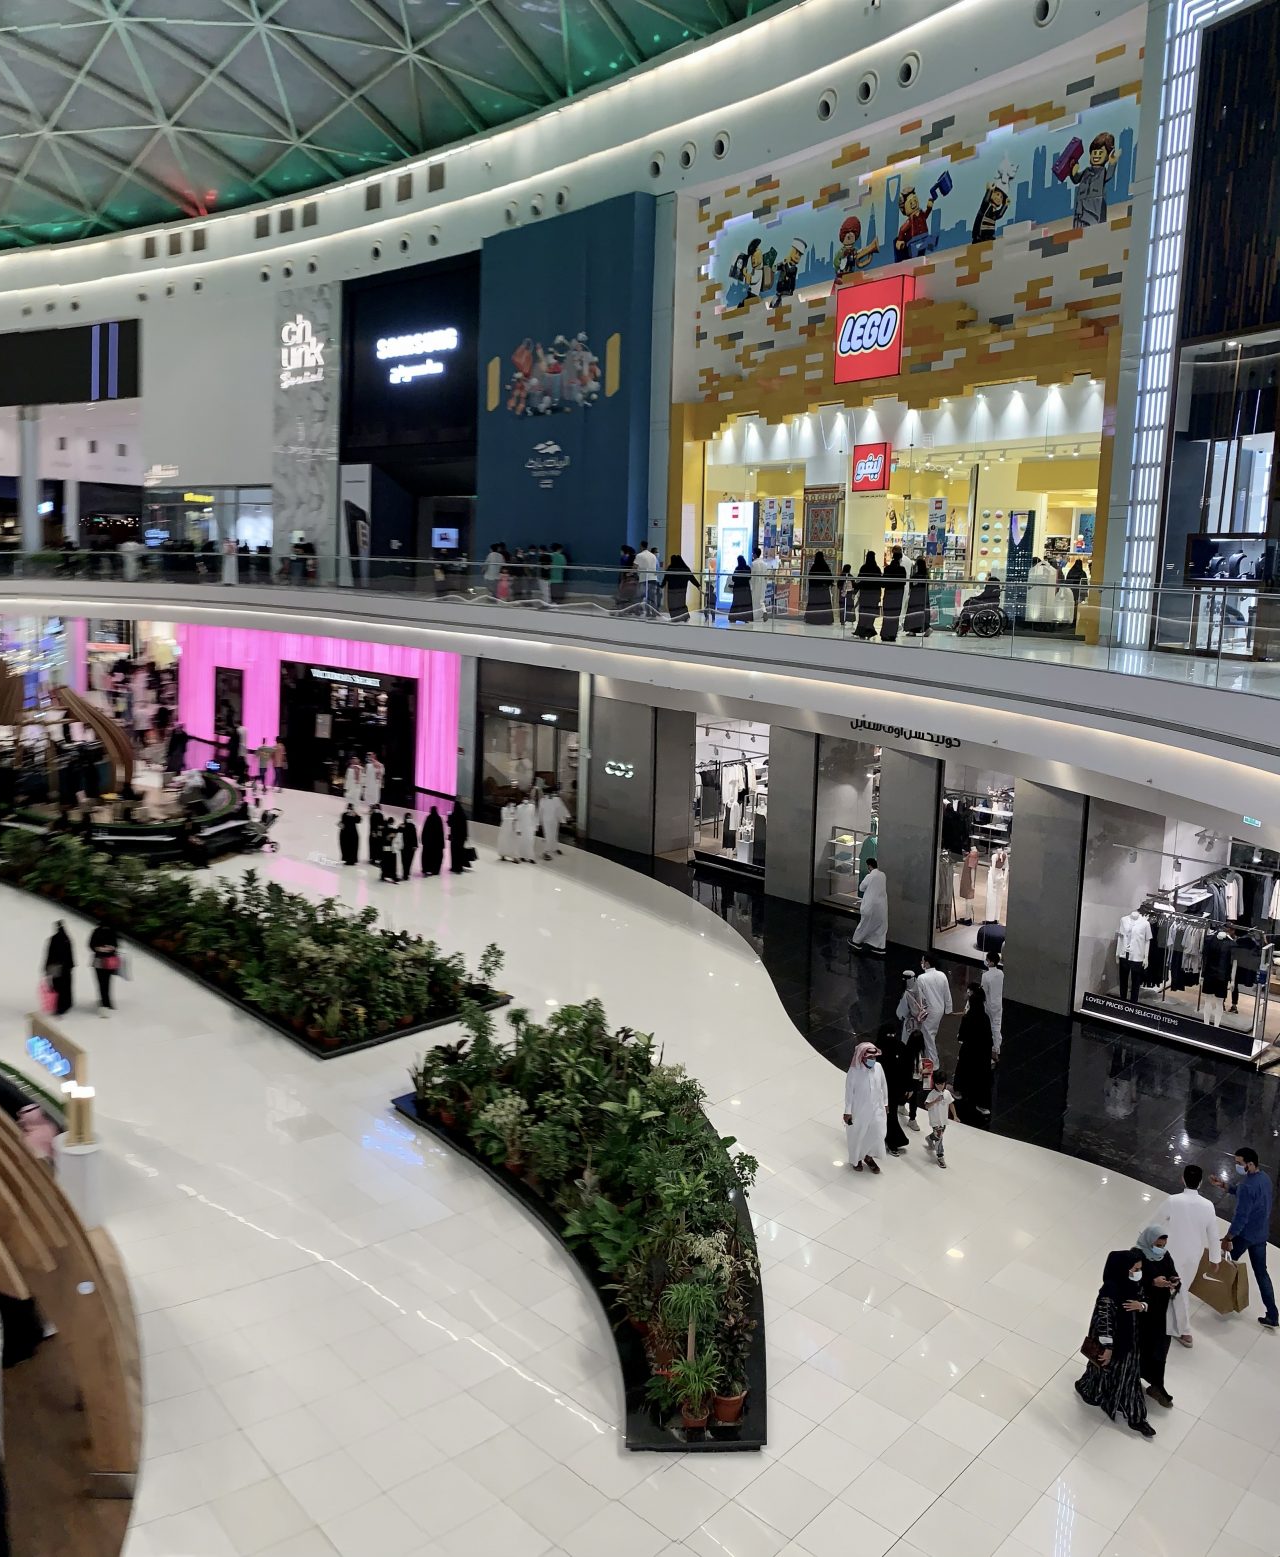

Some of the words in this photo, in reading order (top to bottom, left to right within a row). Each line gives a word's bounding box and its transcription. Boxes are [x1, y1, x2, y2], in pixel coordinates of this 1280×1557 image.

[838, 305, 900, 357] LEGO
[854, 453, 885, 482] ليغو
[1085, 995, 1106, 1005] LOVELY
[1105, 1001, 1124, 1011] PRICES
[1124, 1006, 1135, 1014] ON
[1135, 1009, 1162, 1021] SELECTED
[1162, 1016, 1179, 1026] ITEMS
